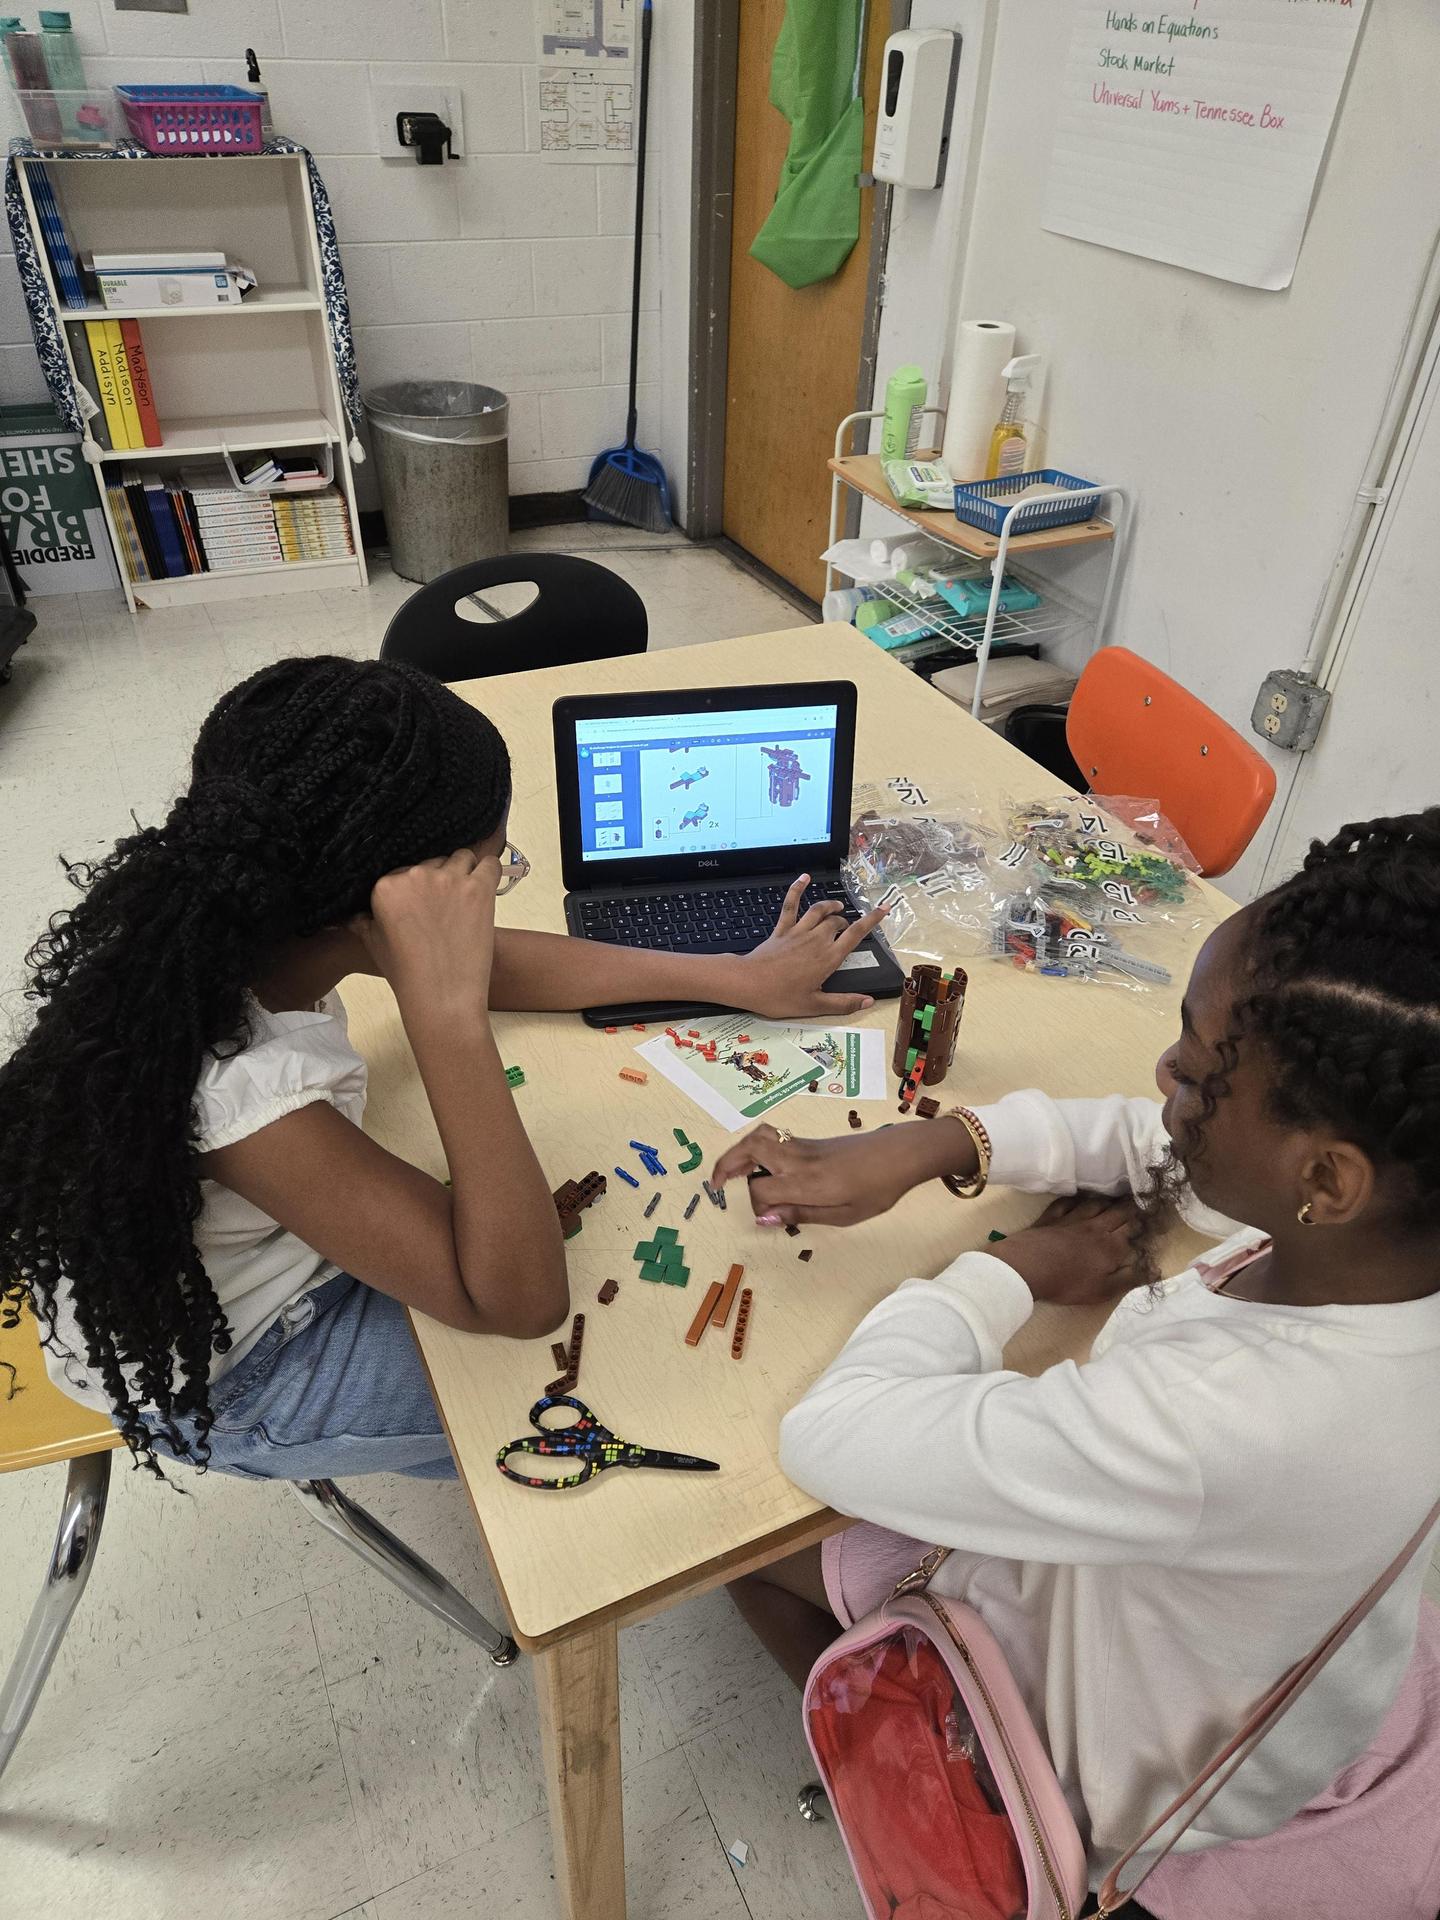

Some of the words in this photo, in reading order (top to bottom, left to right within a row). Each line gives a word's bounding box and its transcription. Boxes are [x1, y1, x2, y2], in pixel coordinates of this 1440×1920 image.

[1106, 10, 1137, 33] Hands
[1142, 20, 1154, 34] on
[1157, 14, 1219, 42] Equations
[1099, 48, 1128, 70] Stock
[1133, 56, 1175, 76] Market
[1093, 81, 1143, 109] Universal
[1193, 100, 1255, 127] Tennessee
[1260, 104, 1284, 129] Box
[97, 349, 117, 406] Addisyn
[113, 342, 133, 406] Madison
[128, 345, 151, 407] Madyson
[0, 485, 52, 513] FO
[11, 543, 96, 567] FREDDIE
[897, 788, 929, 805] 12
[708, 820, 720, 830] 2x
[1079, 813, 1108, 833] 14
[1000, 842, 1028, 867] 11
[1098, 839, 1128, 861] 15
[698, 860, 720, 868] DELL
[1103, 882, 1135, 904] 15
